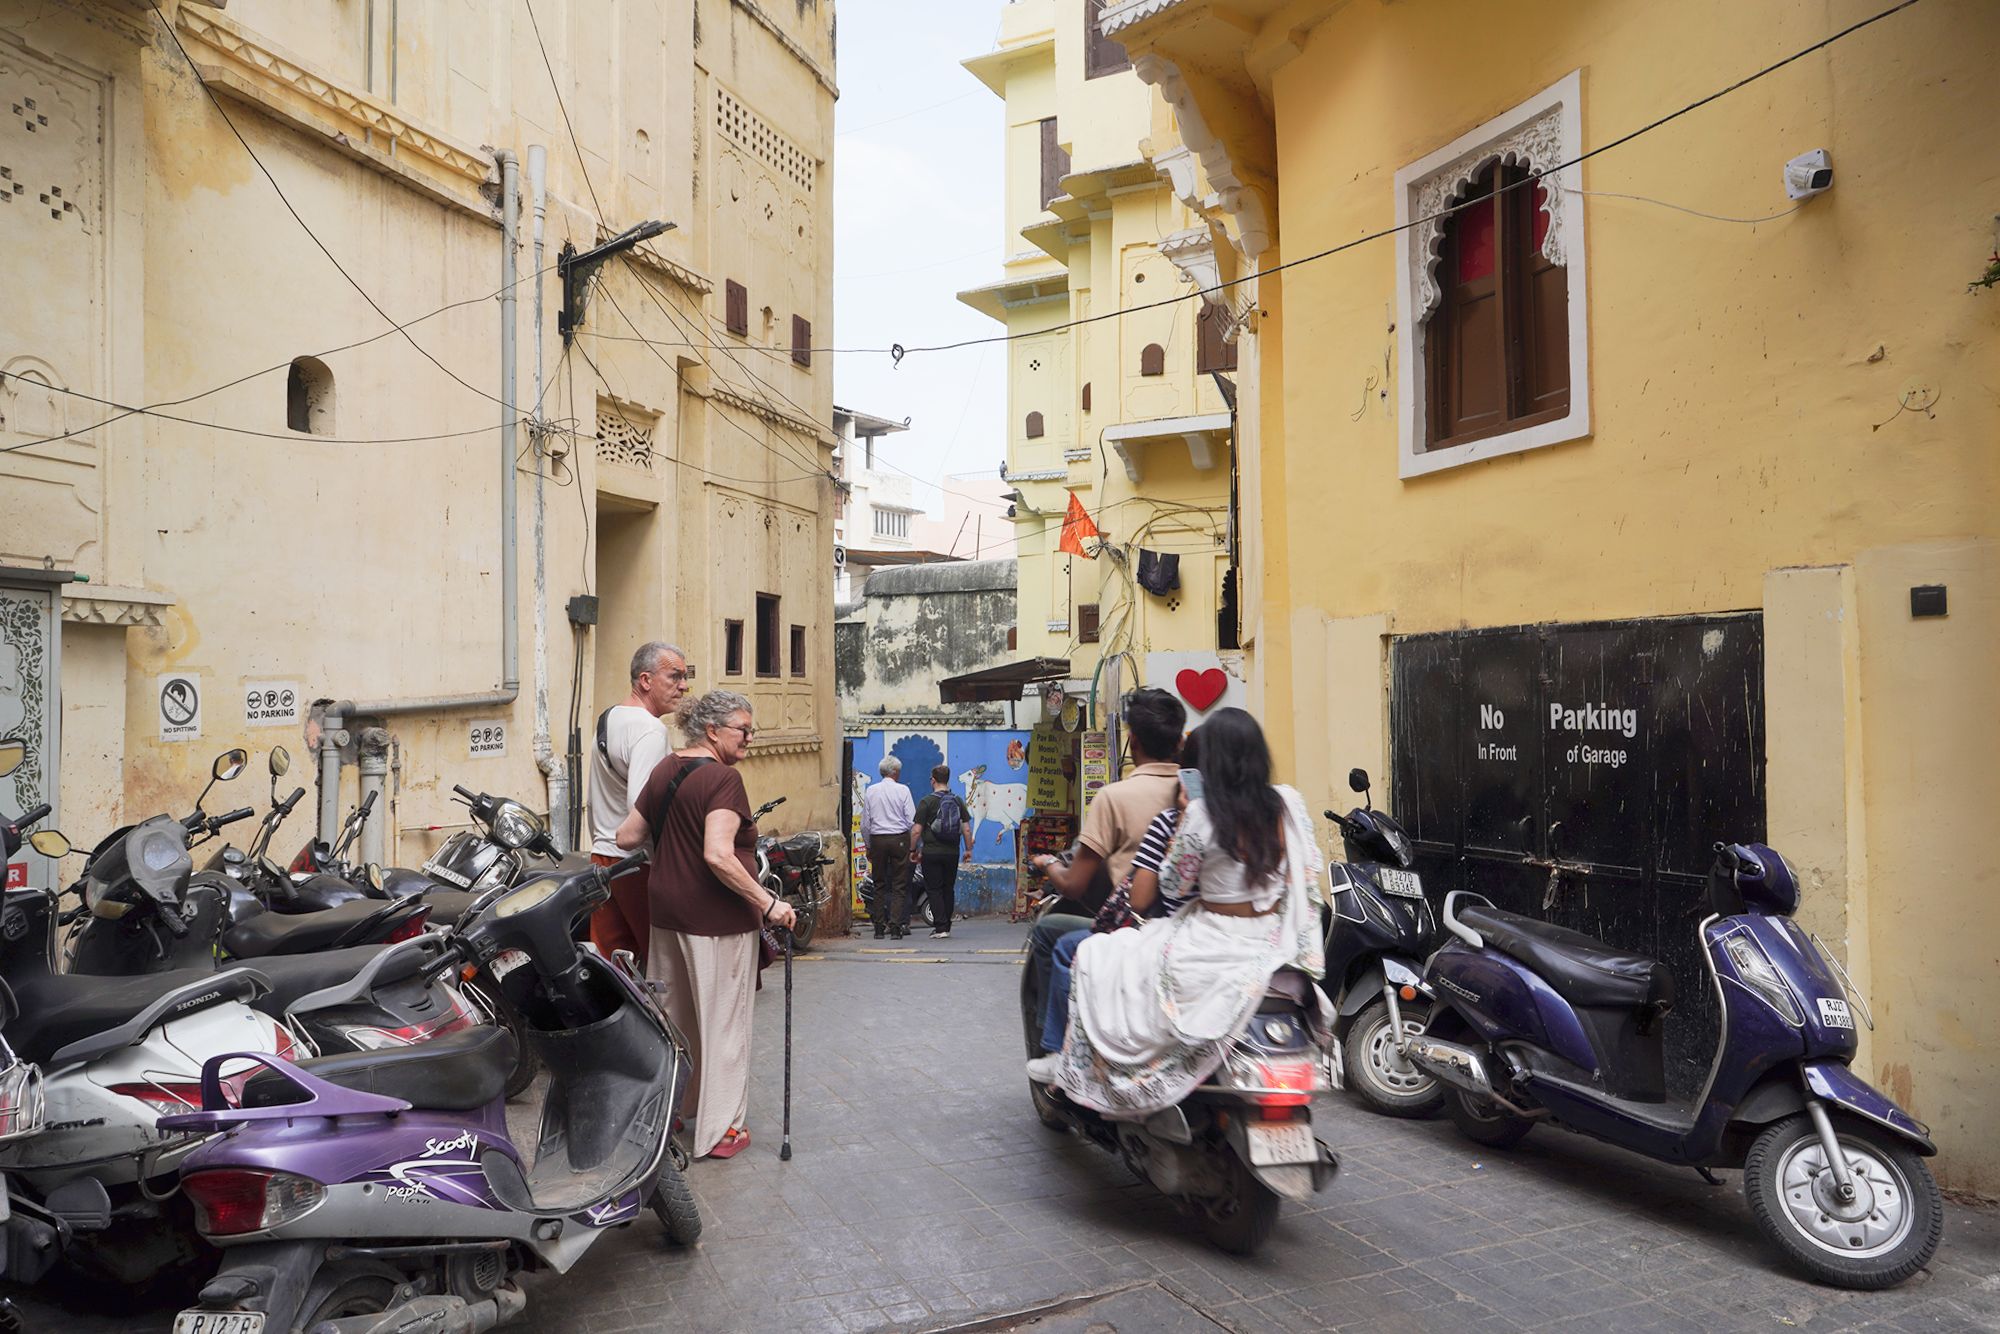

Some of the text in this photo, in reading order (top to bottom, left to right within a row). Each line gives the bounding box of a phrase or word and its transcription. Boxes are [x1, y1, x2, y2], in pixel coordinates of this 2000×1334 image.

[247, 708, 295, 720] NO PARKING
[1480, 703, 1637, 738] No Parking
[173, 725, 197, 733] SPITTING
[480, 743, 503, 751] PARKING
[1478, 743, 1517, 761] In Front
[1040, 756, 1056, 764] Pasta
[1567, 745, 1628, 769] of Garage
[1040, 777, 1054, 785] Poha
[1038, 787, 1056, 798] Maggi
[1031, 798, 1060, 808] Sandwich
[176, 991, 222, 1012] HONDA
[418, 1129, 479, 1161] Scooty
